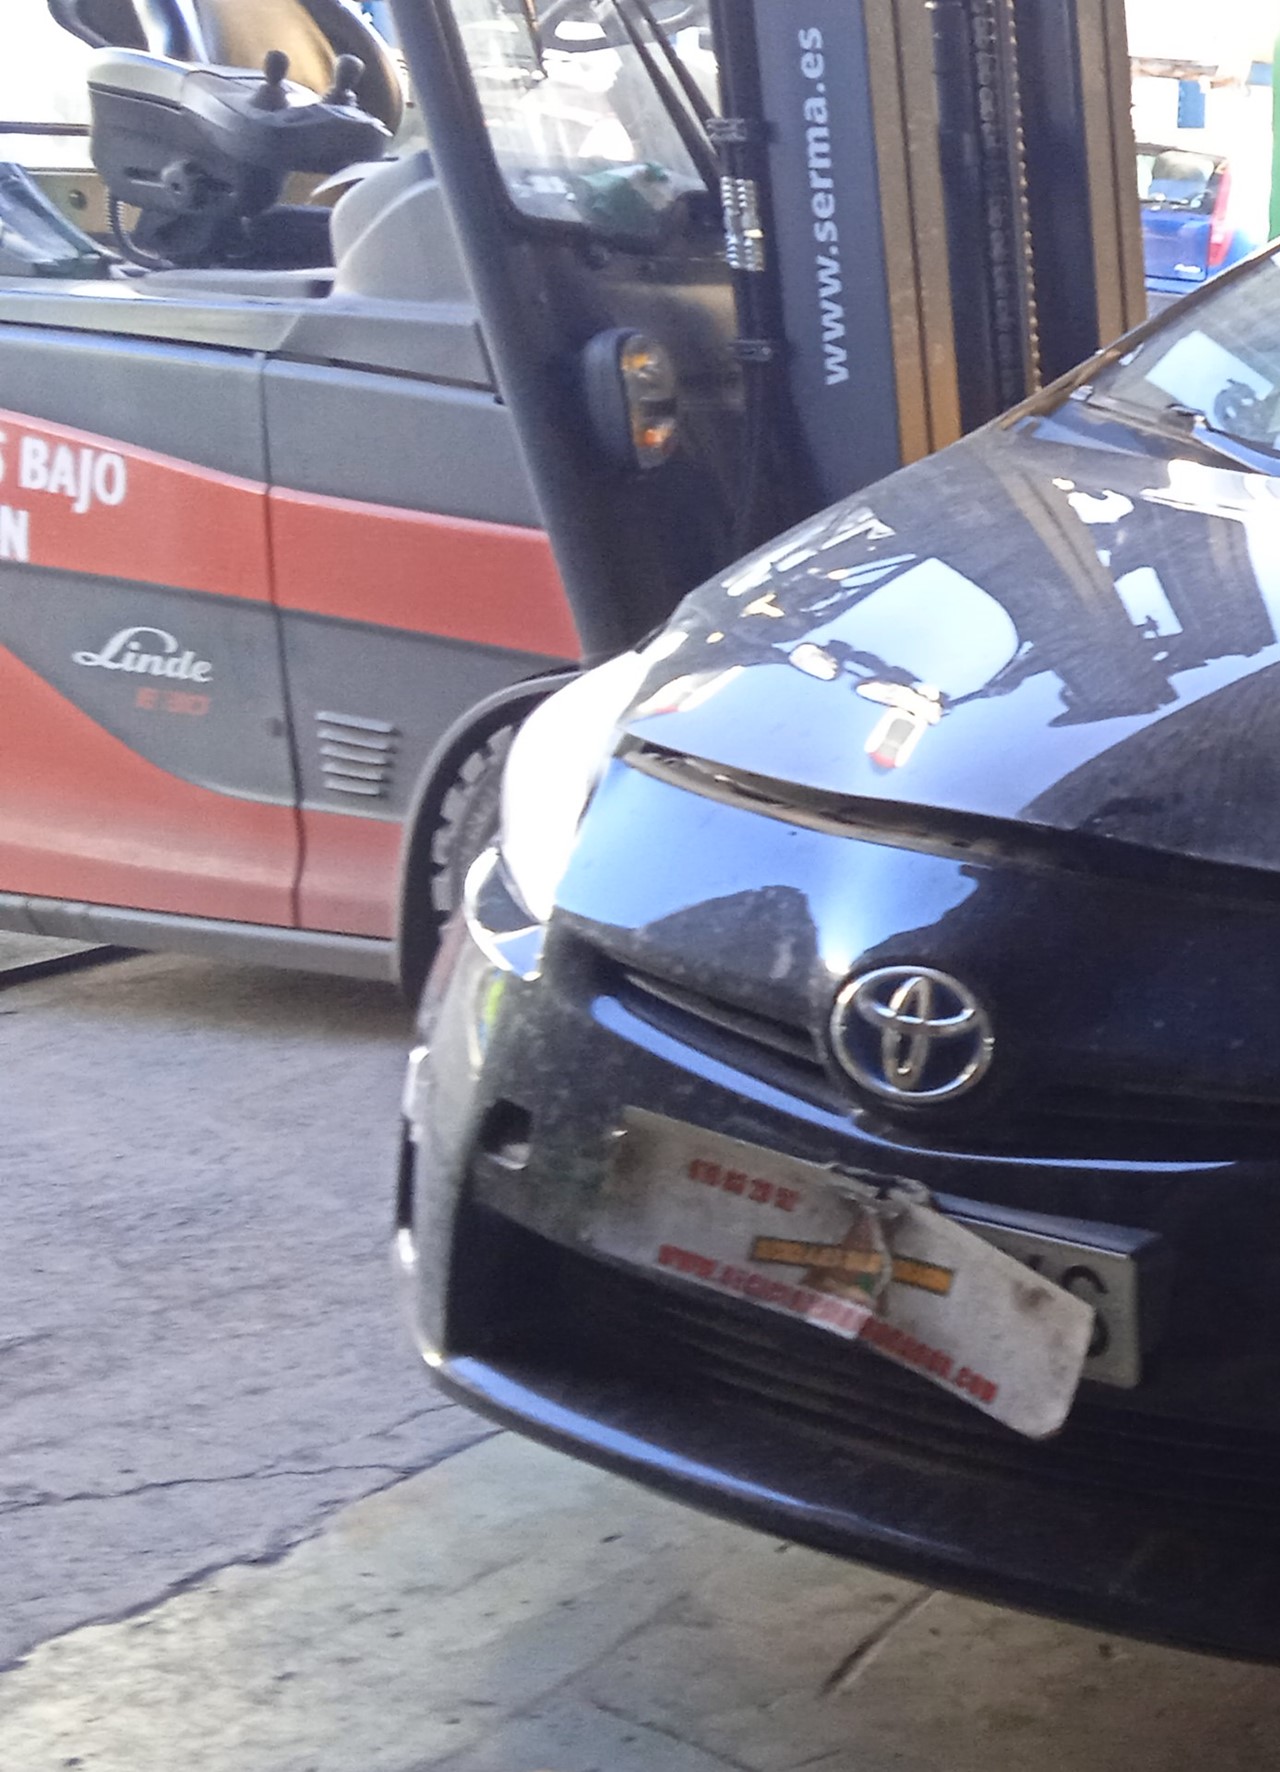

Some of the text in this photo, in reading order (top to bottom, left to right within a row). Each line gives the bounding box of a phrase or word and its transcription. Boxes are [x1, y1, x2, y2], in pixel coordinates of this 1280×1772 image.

[798, 26, 851, 386] www.serma.es
[20, 435, 127, 514] BAJO
[72, 626, 214, 684] Linde
